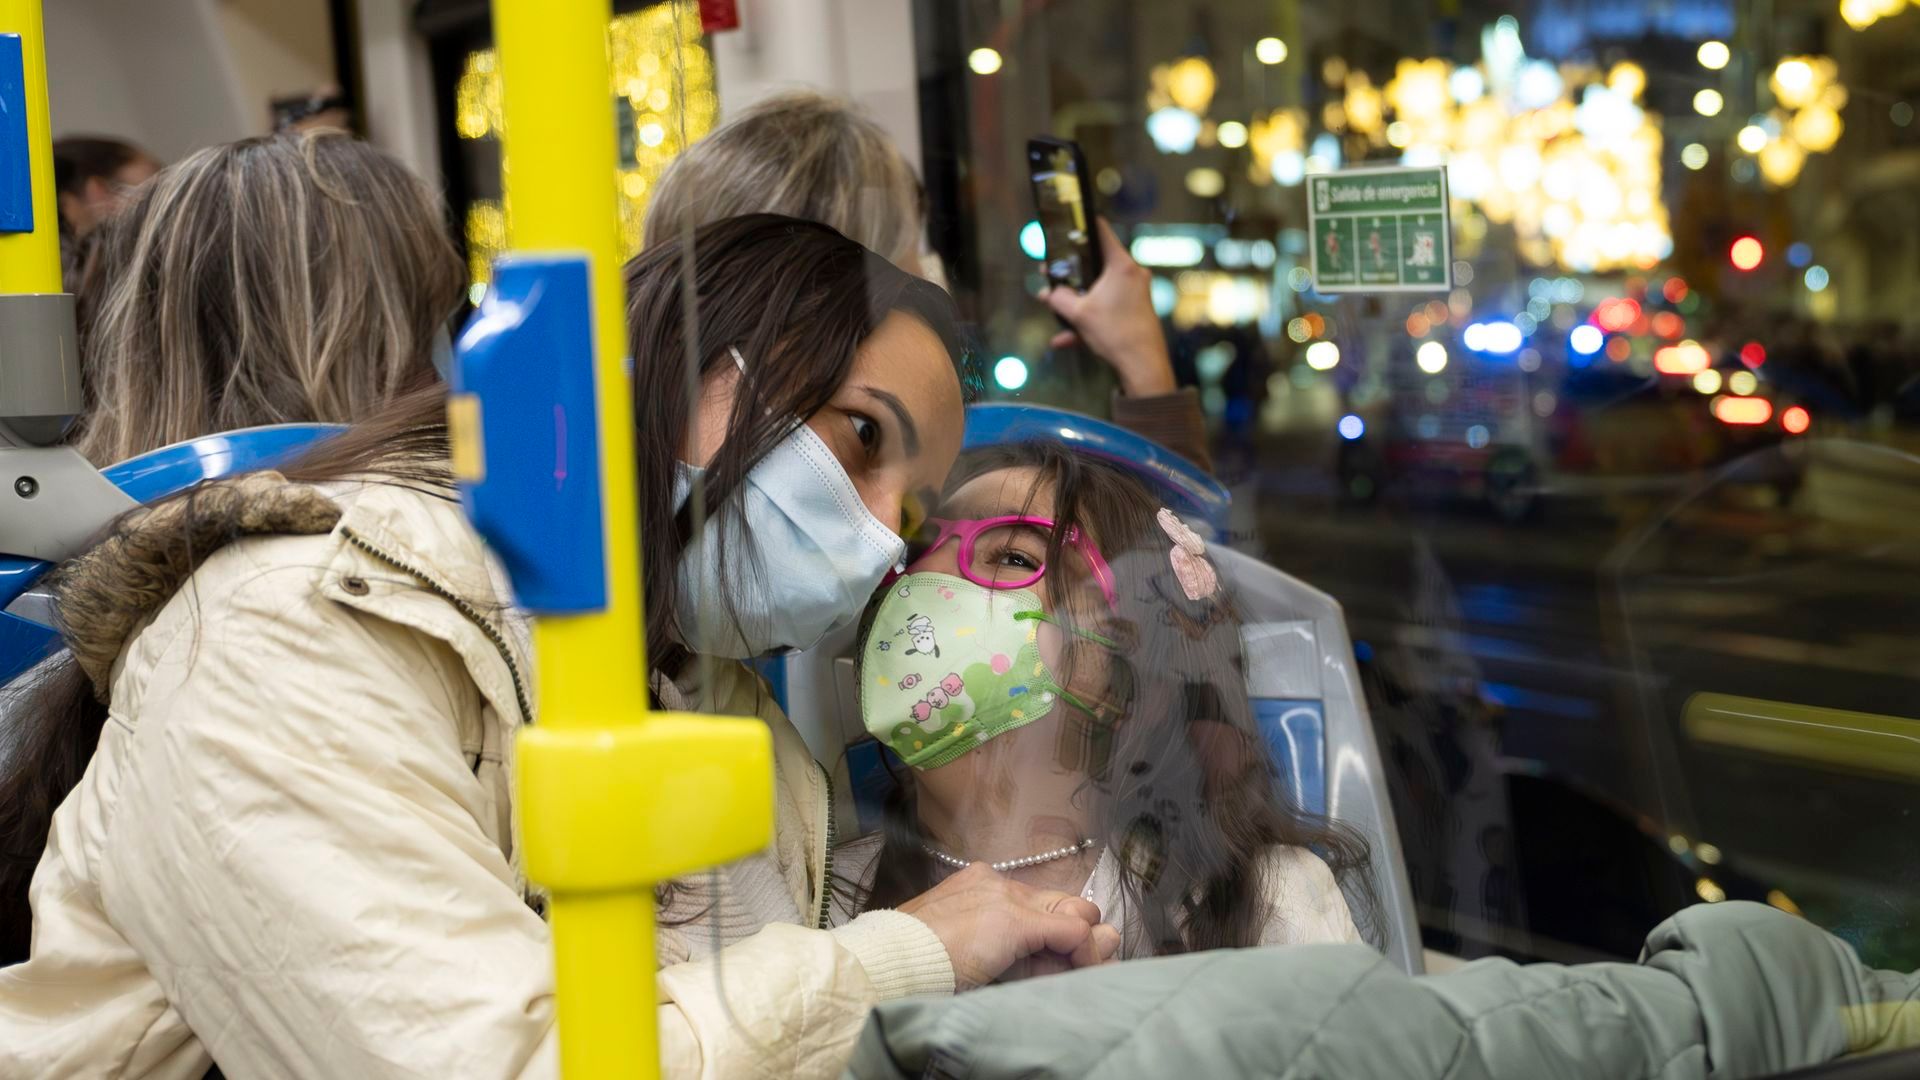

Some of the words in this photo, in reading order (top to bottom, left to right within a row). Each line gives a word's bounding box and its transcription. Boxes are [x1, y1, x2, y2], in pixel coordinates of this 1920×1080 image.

[1331, 185, 1361, 202] Salida
[1363, 185, 1376, 201] de
[1377, 183, 1438, 203] emergencia
